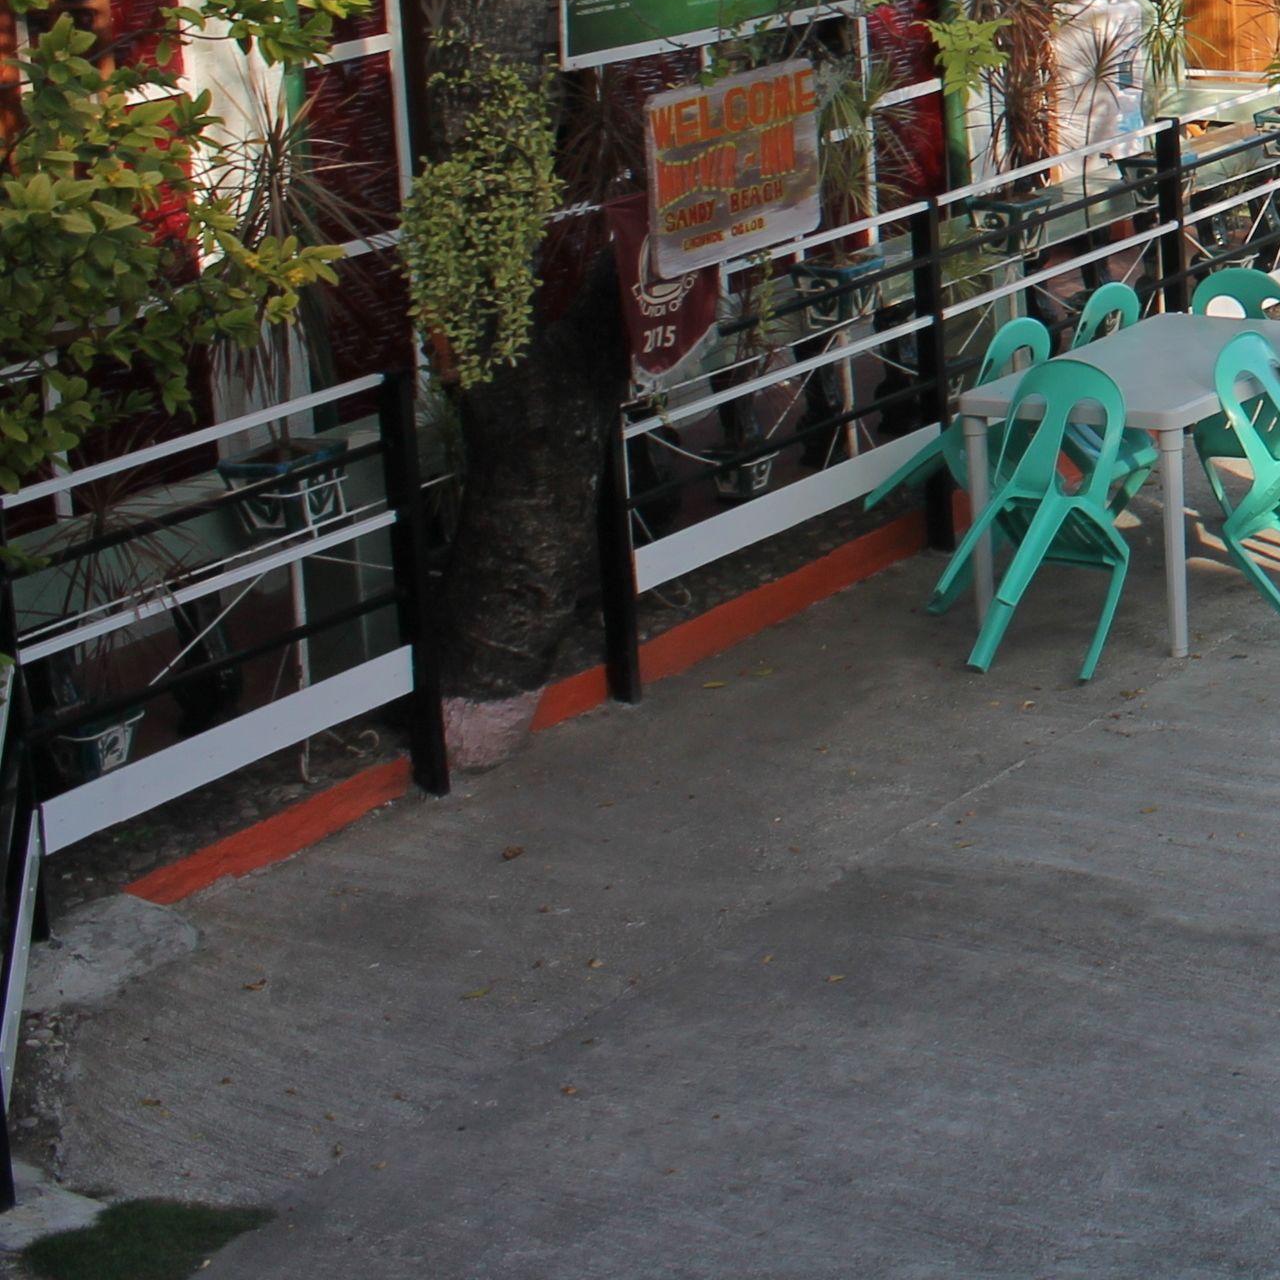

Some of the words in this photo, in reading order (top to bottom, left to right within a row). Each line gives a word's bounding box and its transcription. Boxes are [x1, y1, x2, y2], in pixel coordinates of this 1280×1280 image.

[650, 69, 817, 150] WELCOME
[665, 199, 717, 233] SANDY
[729, 179, 784, 216] BEACH
